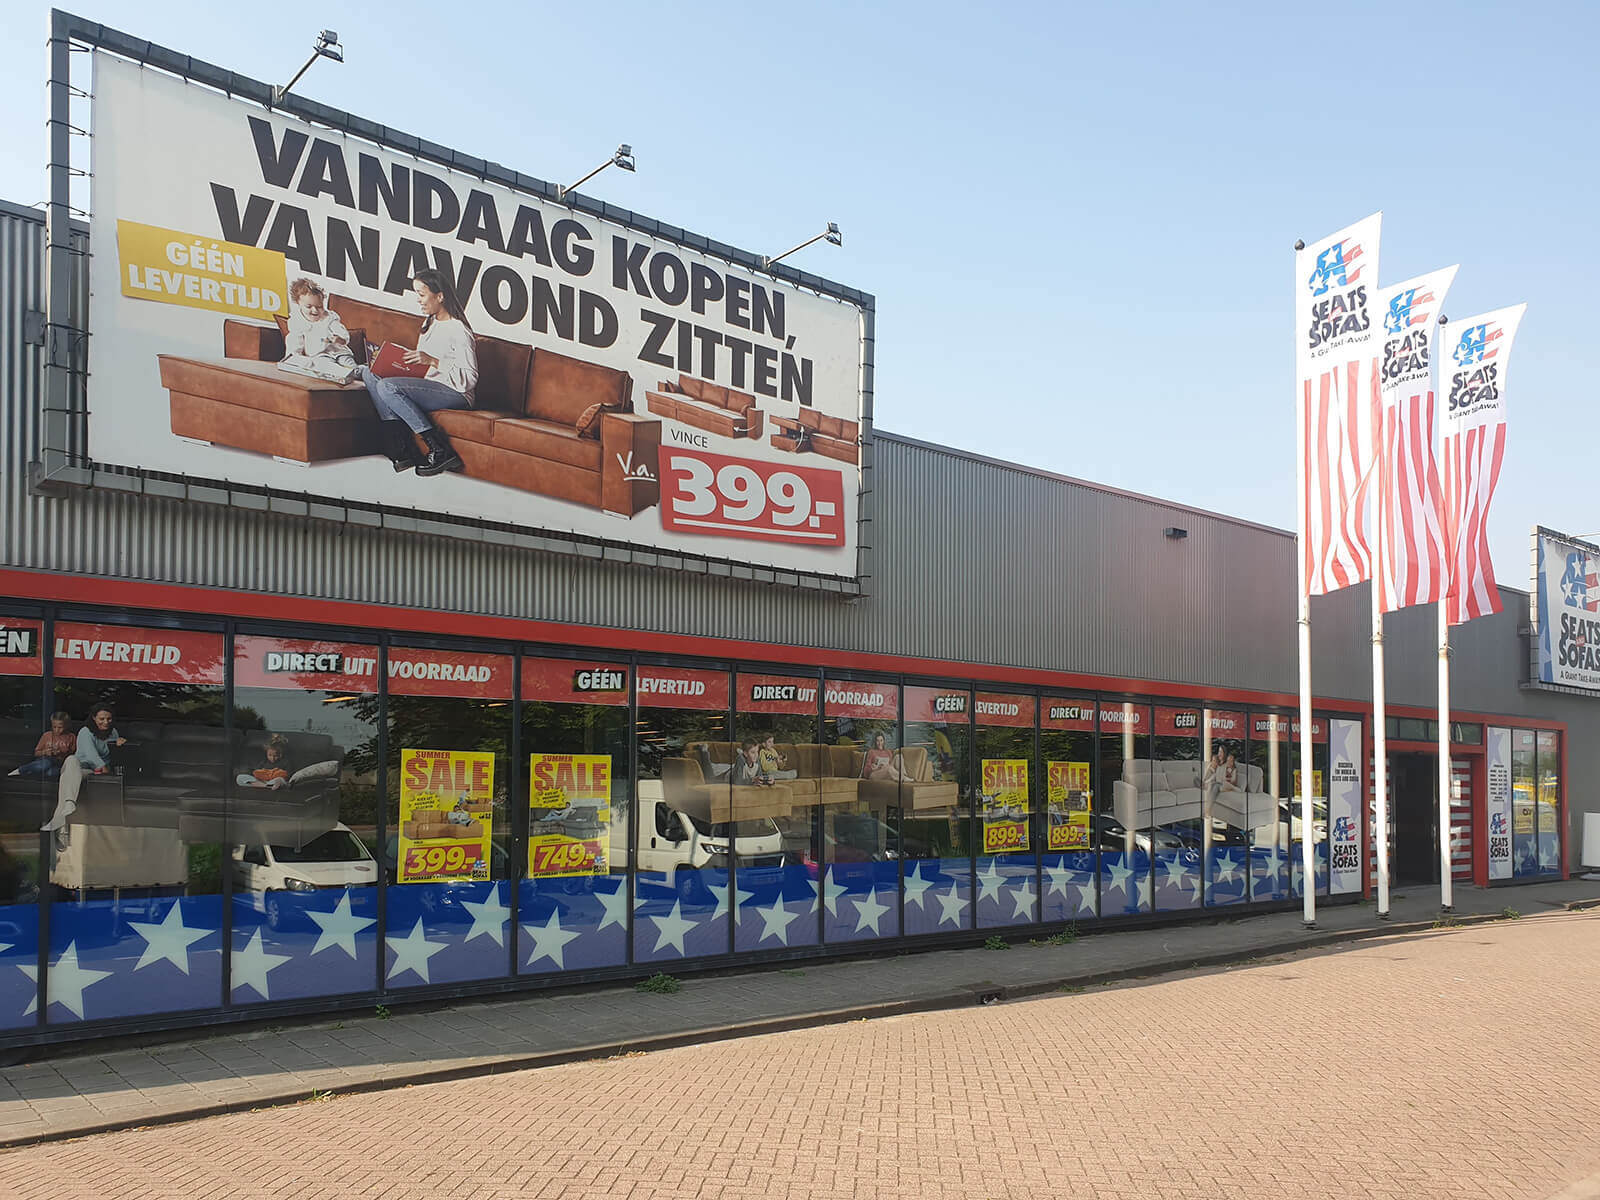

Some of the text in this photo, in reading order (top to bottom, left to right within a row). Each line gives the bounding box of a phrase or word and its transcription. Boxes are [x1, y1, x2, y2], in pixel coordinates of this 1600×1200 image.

[247, 114, 798, 350] VANDAAG KOPEN,
[166, 241, 244, 278] GÉÉN
[128, 263, 282, 313] LEVERTIJD
[209, 181, 814, 407] VANAVOND ZITTEN
[1312, 285, 1367, 324] SEATS
[1309, 308, 1370, 349] SOFAS
[1449, 381, 1498, 411] SOFAS
[670, 428, 708, 449] VINCE
[670, 456, 836, 529] 399.-
[1561, 612, 1600, 645] SEATS
[54, 638, 182, 666] LEVERTIJD
[1559, 640, 1600, 672] SOFAS
[267, 652, 491, 683] DIRECT UIT VOORRAAD
[577, 668, 706, 696] GÉÉN LEVERTIJD
[753, 686, 884, 707] DIRECT UIT VOORRAAD
[936, 694, 1019, 716] GÉÉN LEVERTIJD
[1050, 707, 1080, 720] DIRECT
[1080, 709, 1095, 721] UIT
[1176, 712, 1197, 728] GÉÉN
[416, 751, 451, 760] SUMMER
[405, 758, 489, 791] SALE
[535, 762, 608, 792] SALE
[984, 765, 1026, 788] SALE
[1049, 767, 1088, 791] SALE
[1333, 844, 1358, 857] SEATS
[1490, 837, 1509, 848] SEATS
[1490, 846, 1509, 858] SOFAS
[408, 847, 477, 874] 399.-
[1332, 855, 1359, 869] SOFAS
